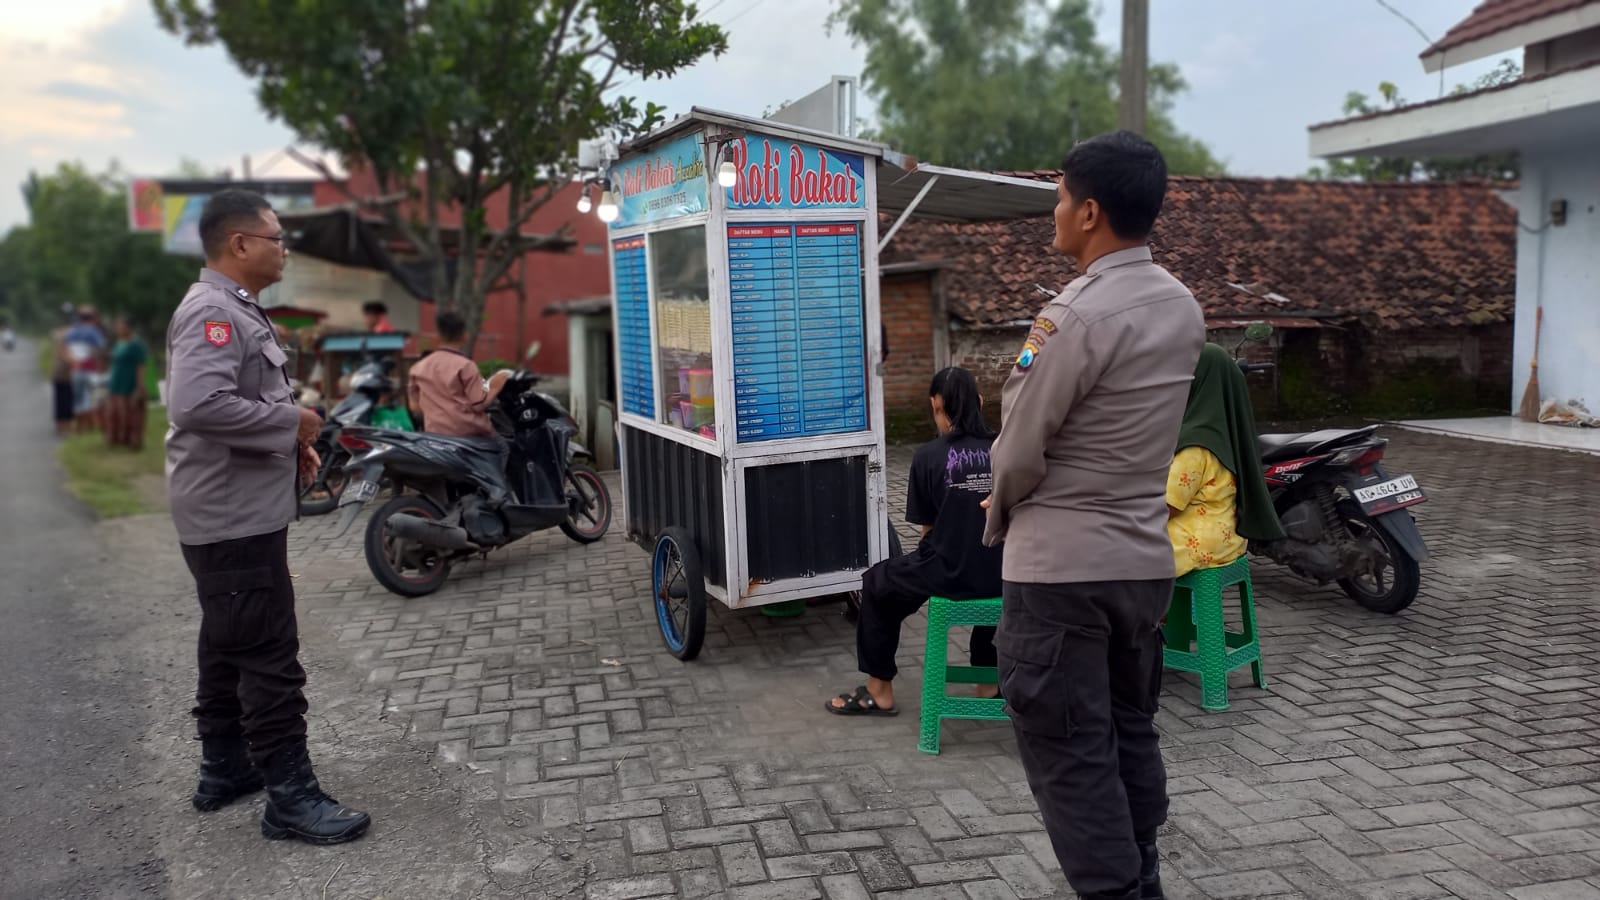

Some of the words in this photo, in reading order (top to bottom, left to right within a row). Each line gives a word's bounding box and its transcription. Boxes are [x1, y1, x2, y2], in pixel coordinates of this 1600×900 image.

[623, 164, 642, 197] Roti
[644, 157, 676, 192] Bakar
[732, 136, 783, 206] Roti
[788, 143, 859, 205] Bakar
[1376, 483, 1400, 496] 4642
[1400, 478, 1415, 489] UH
